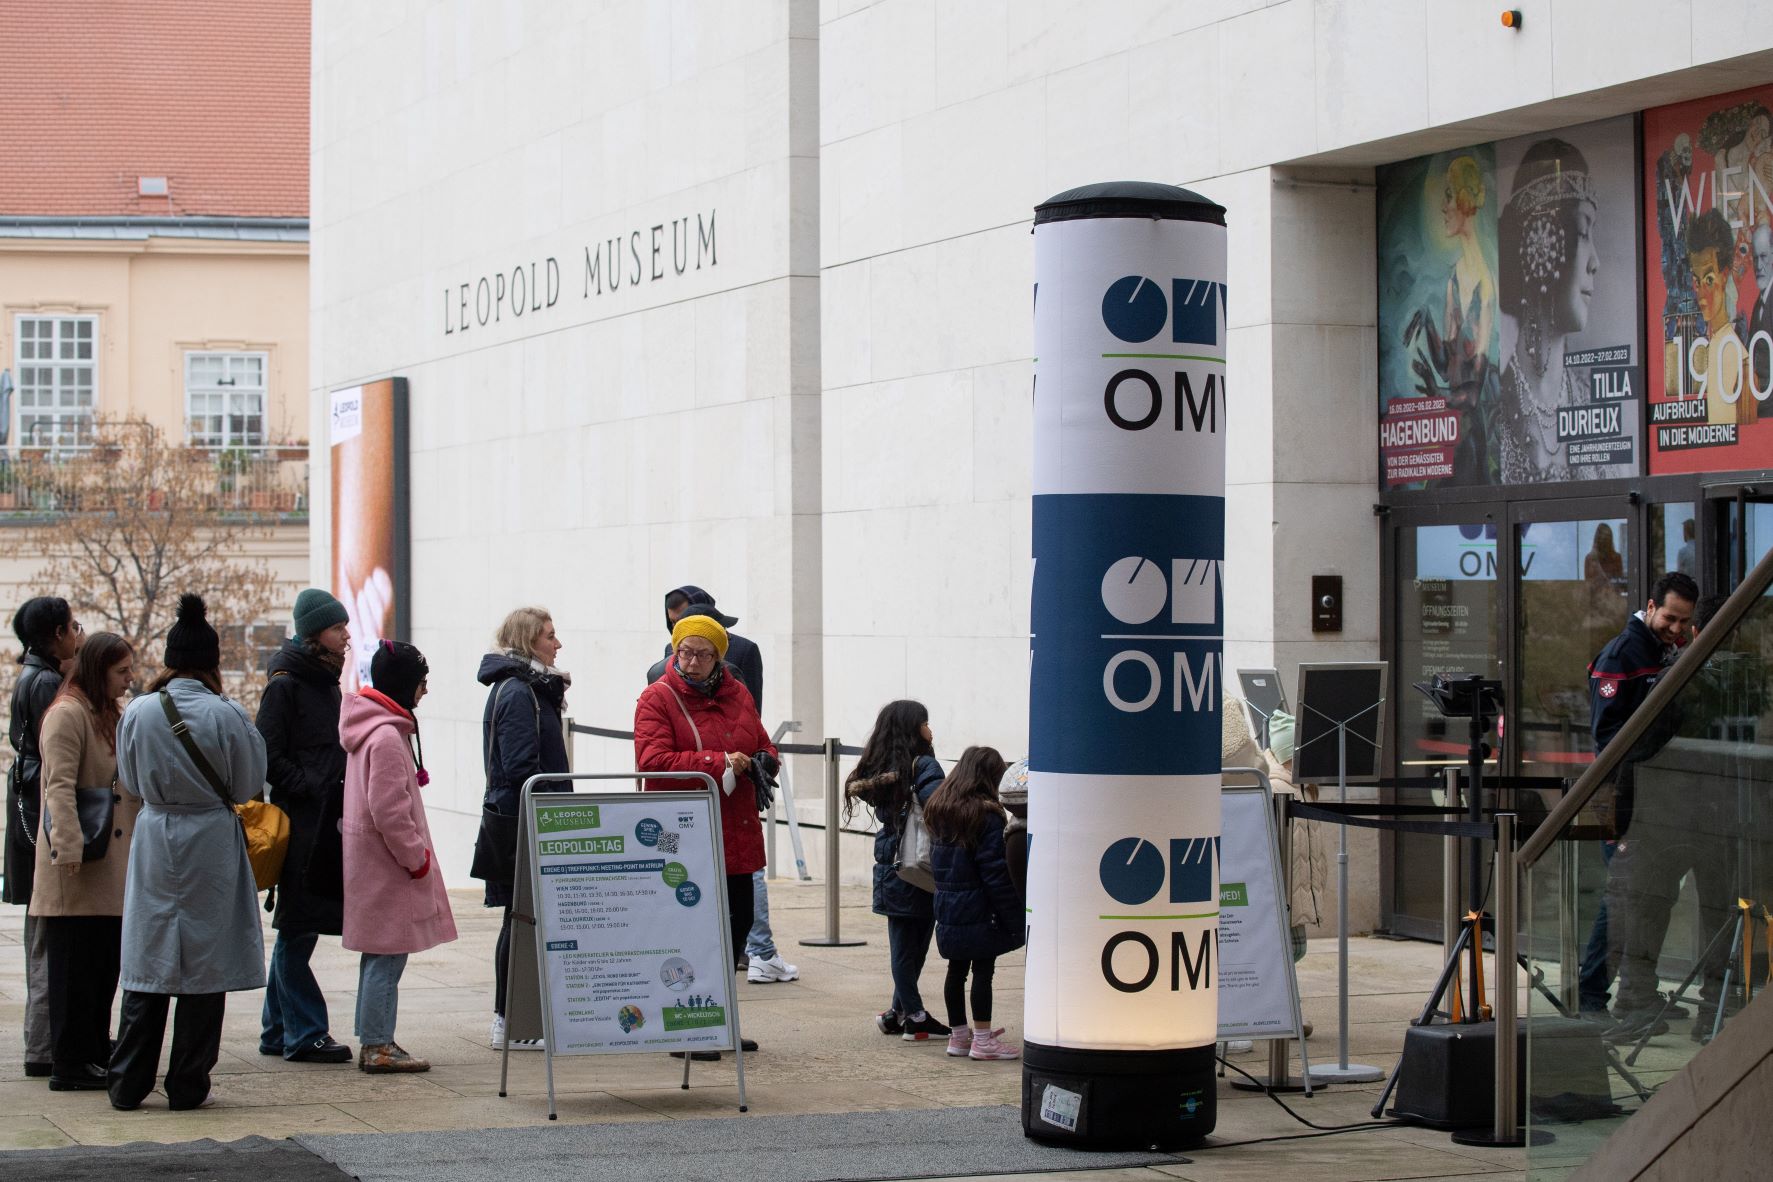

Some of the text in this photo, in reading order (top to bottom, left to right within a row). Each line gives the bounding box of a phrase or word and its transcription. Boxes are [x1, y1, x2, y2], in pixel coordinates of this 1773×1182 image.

[1665, 163, 1773, 239] WIEN
[445, 208, 717, 335] LEOPOLD MUSEUM
[1673, 329, 1773, 404] 1900
[1593, 370, 1632, 399] TILLA
[1104, 369, 1226, 433] OM
[1653, 400, 1706, 421] AUFBRUCH
[1380, 416, 1458, 448] HAGENBUND
[1559, 407, 1619, 437] DURIEUX
[1569, 441, 1632, 454] EINE JAHRHUNDERTZEUGIN
[1660, 424, 1737, 446] IN DIE MODERNE
[1387, 452, 1444, 467] VON DER GEMÄSSIGTEN
[1569, 452, 1611, 464] UND IHRE ROLLEN
[1387, 464, 1453, 480] ZUR RADIKALEN MODERNE
[1103, 650, 1224, 713] OM
[553, 811, 594, 819] LEOPOLD
[554, 817, 595, 827] MUSEUM
[540, 839, 623, 855] LEOPOLDI-TAG
[1101, 928, 1219, 993] OM
